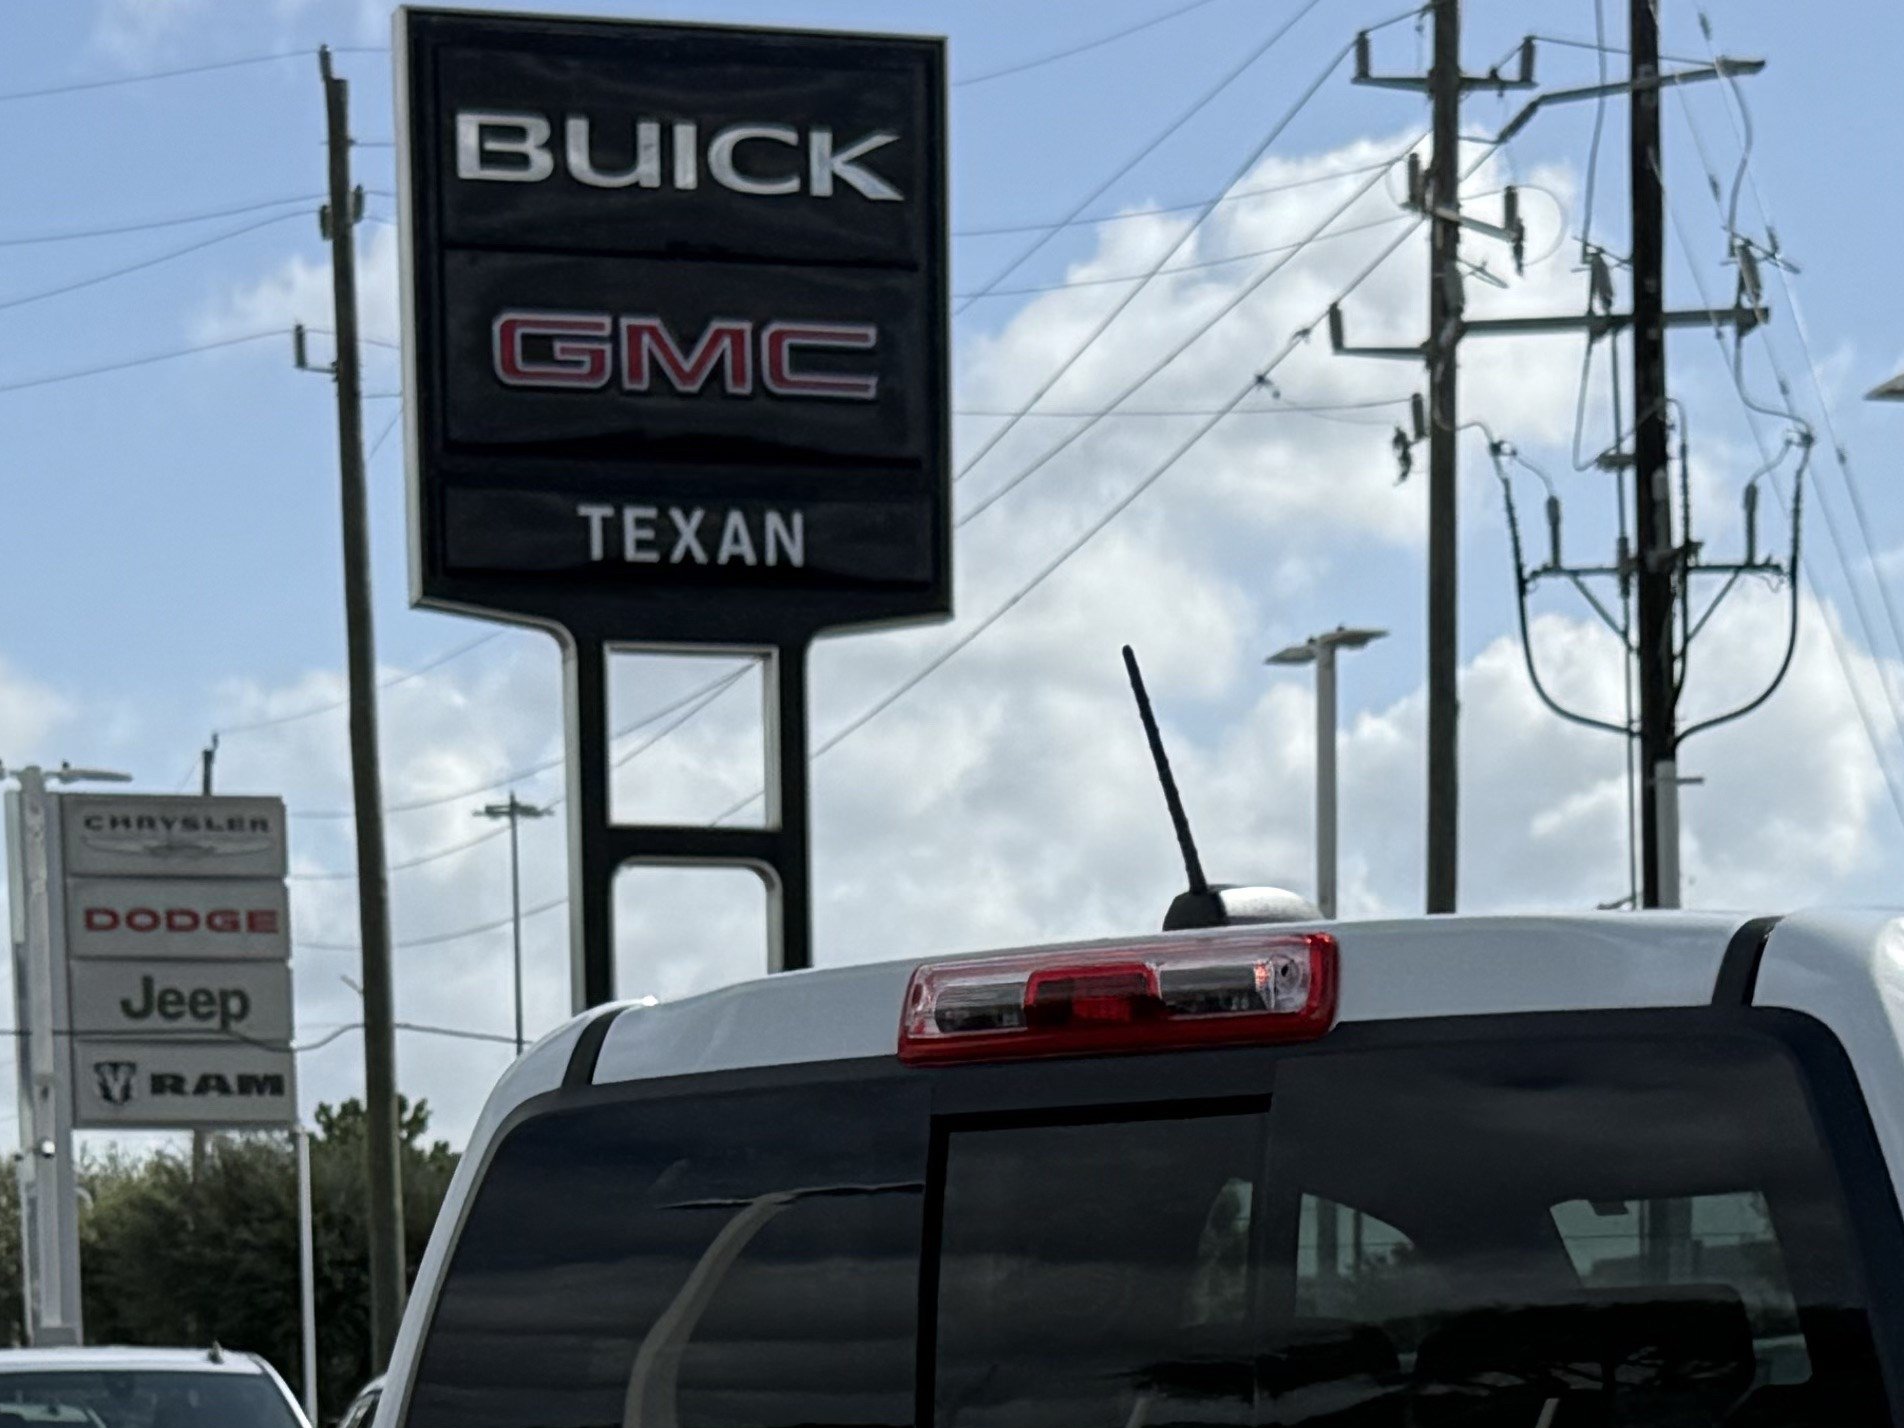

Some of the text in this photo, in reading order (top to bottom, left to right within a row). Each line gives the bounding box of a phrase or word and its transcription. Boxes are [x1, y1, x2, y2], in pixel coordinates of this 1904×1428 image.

[455, 112, 904, 201] BUICK
[493, 309, 878, 400] GMC
[577, 504, 806, 568] TEXAN
[83, 815, 269, 833] CHRYSLER
[83, 907, 279, 933] DODGE
[120, 974, 251, 1032] Jeep
[150, 1073, 286, 1098] RAM
